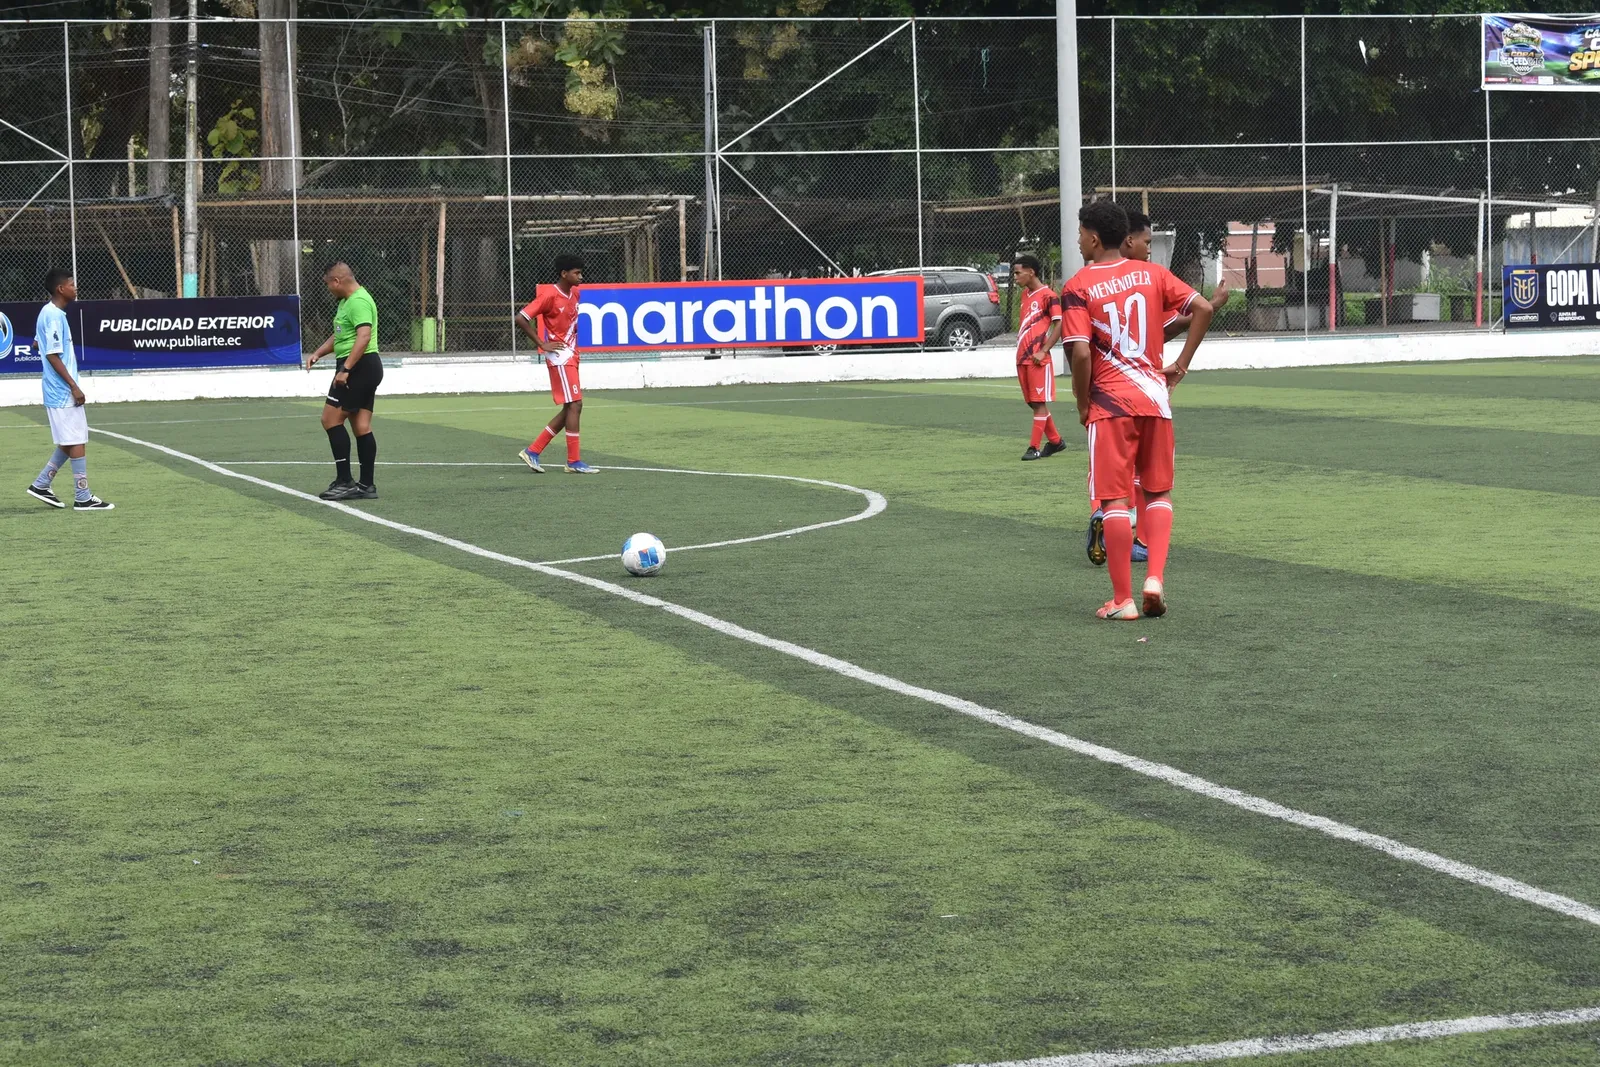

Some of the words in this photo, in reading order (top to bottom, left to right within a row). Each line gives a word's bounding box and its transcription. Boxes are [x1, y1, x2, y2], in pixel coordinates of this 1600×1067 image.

[1546, 269, 1589, 306] COPA
[100, 318, 194, 332] PUBLICIDAD
[198, 316, 274, 330] EXTERIOR
[577, 286, 898, 345] marathon
[1102, 292, 1147, 361] 10
[134, 335, 241, 350] www.publiarte.ec
[573, 384, 579, 394] 8
